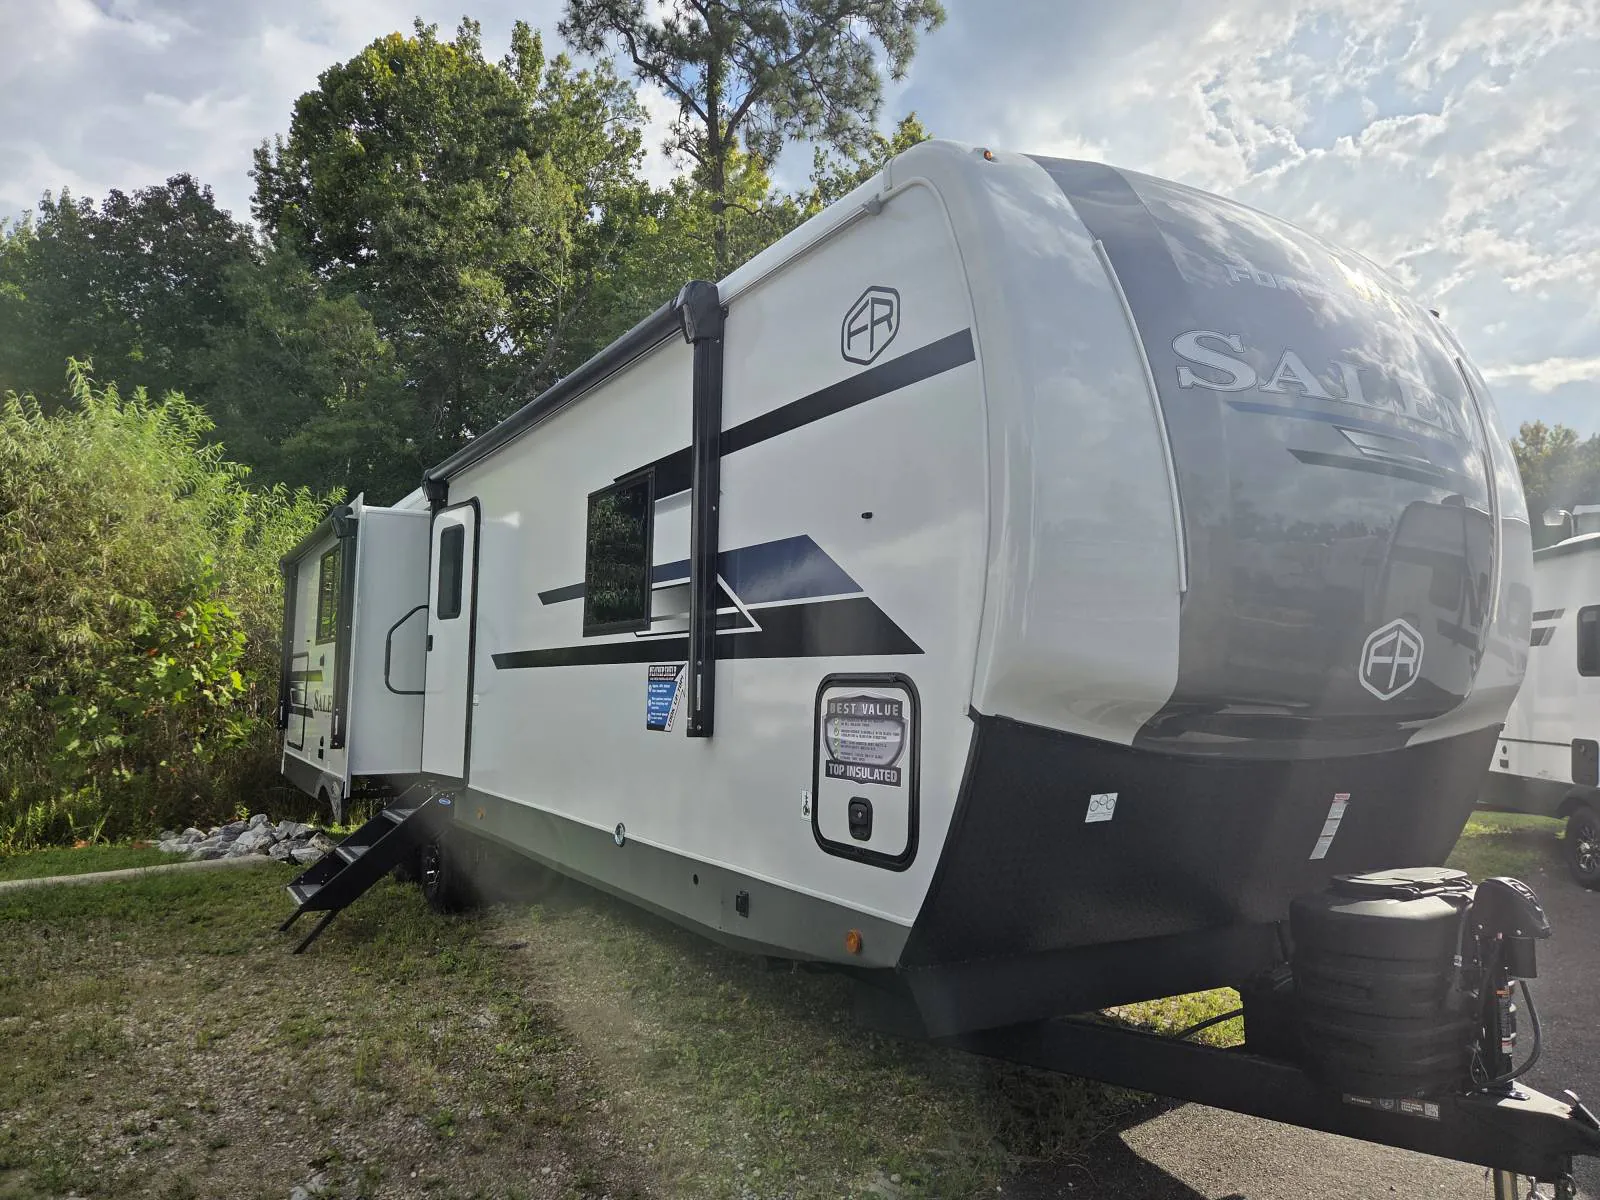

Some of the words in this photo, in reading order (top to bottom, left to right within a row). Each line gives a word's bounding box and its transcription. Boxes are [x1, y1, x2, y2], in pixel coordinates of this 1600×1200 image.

[313, 690, 332, 713] SALE
[830, 703, 856, 714] BEST
[862, 704, 899, 716] VALUE
[829, 763, 844, 775] TOP
[847, 766, 898, 782] INSULATED
